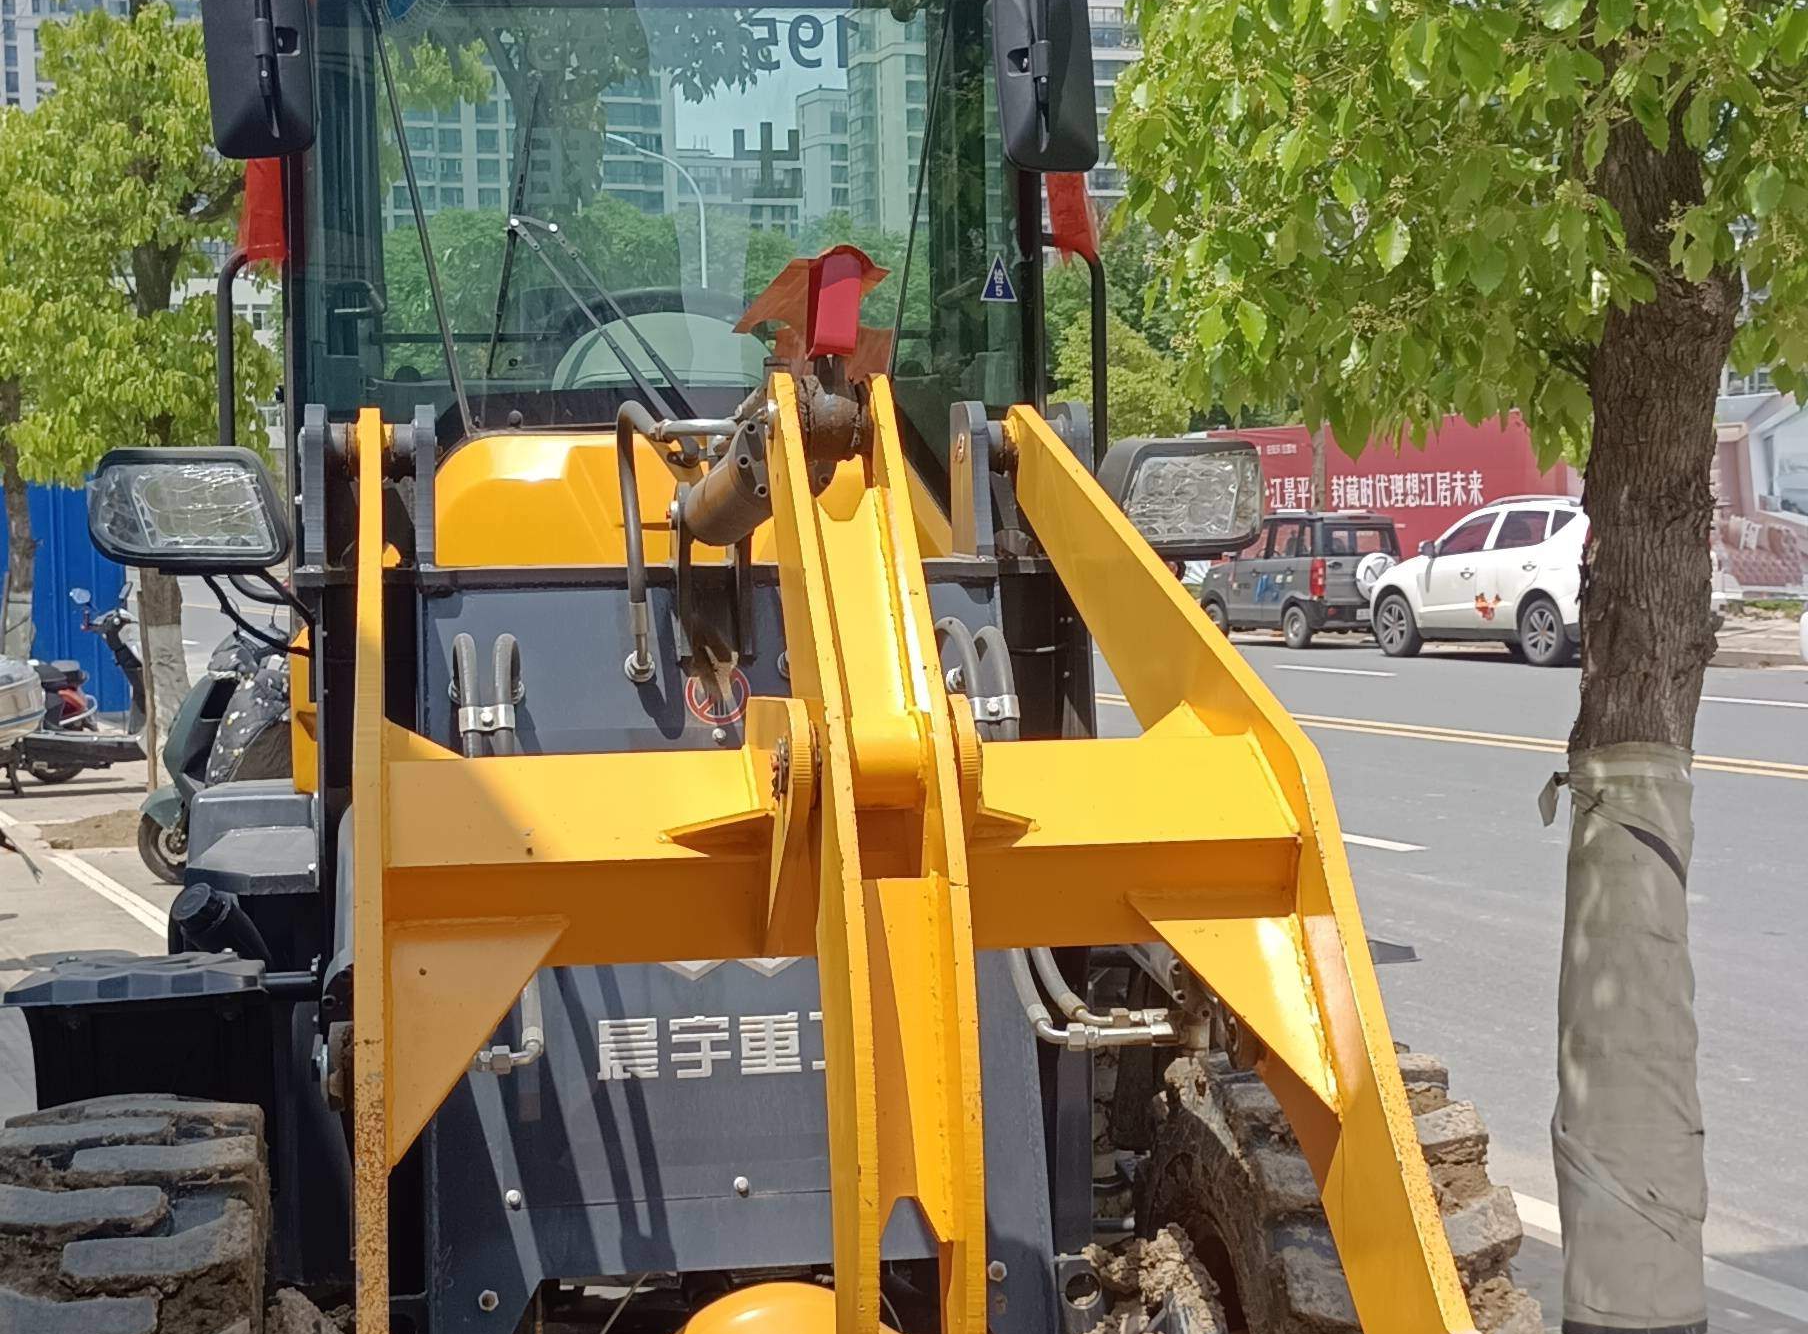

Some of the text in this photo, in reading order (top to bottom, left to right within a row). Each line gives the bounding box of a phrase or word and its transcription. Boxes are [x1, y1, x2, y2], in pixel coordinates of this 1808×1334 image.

[995, 285, 1004, 297] 5
[1264, 470, 1485, 510] 江景平 封藏时代理想江居未来
[597, 1010, 826, 1080] 晨宇重
